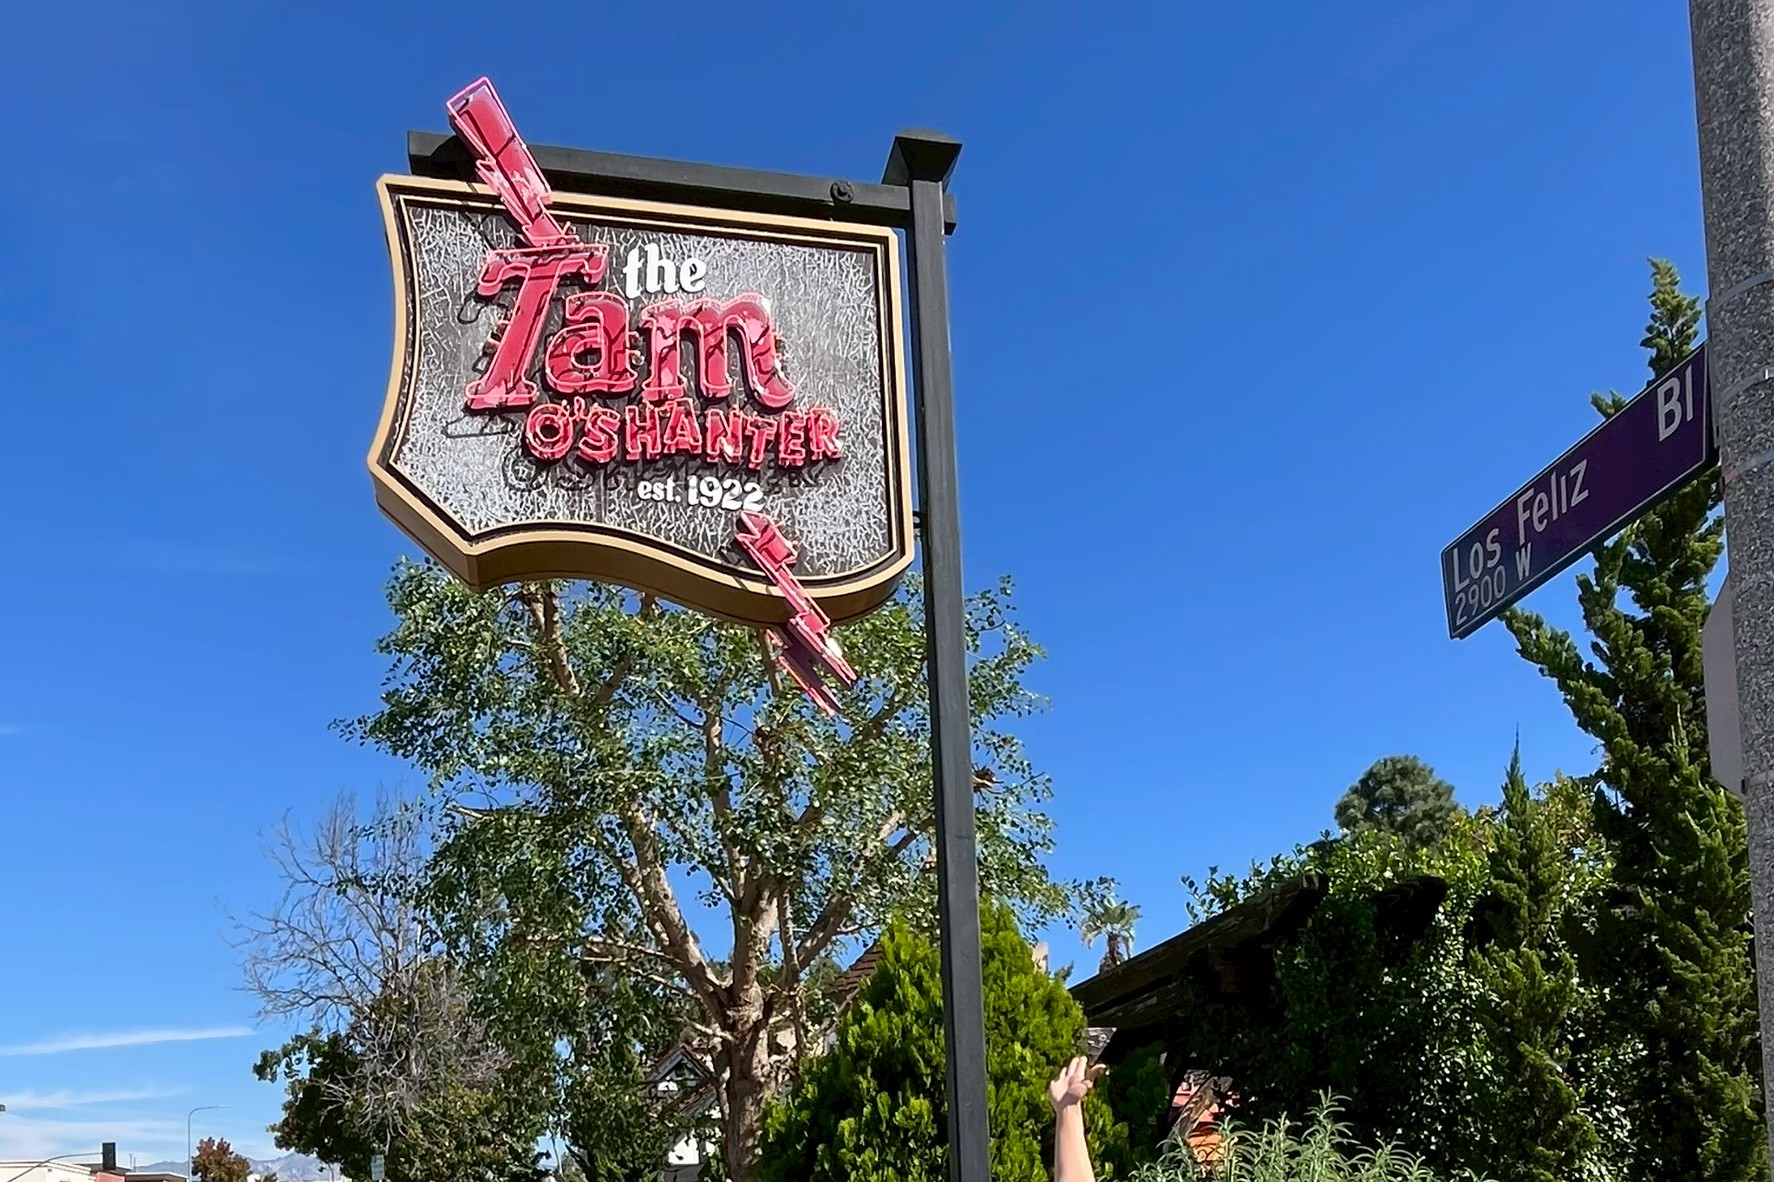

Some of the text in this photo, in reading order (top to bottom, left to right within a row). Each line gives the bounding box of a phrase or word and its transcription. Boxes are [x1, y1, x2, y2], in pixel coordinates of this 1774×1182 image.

[623, 242, 708, 299] the
[464, 244, 797, 411] Tam
[526, 398, 843, 468] O'SHANTER
[637, 475, 766, 512] est. 1922
[1452, 364, 1694, 593] Los Feliz Bl
[1454, 542, 1532, 627] 2900 W
